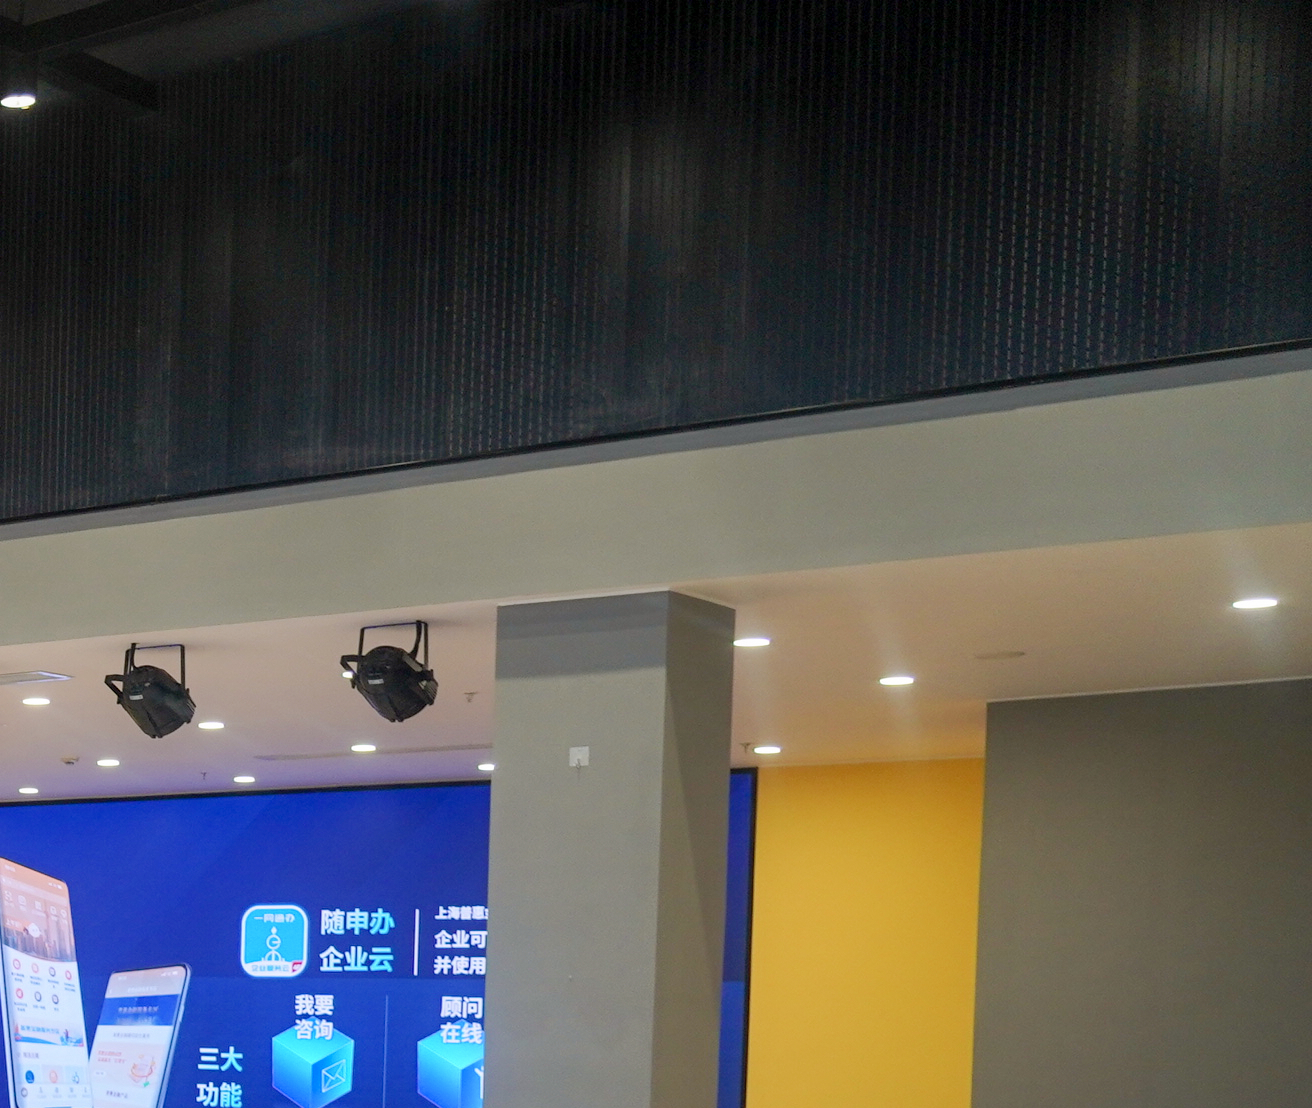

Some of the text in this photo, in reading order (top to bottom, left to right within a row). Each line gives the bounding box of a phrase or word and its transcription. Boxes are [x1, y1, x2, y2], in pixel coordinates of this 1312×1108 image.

[320, 908, 395, 936] 随申办
[434, 930, 488, 949] 企业可
[319, 945, 394, 973] 企业云
[433, 955, 486, 975] 并使用
[294, 994, 334, 1016] 我要
[440, 996, 483, 1019] 顾问
[294, 1019, 334, 1041] 咨询
[440, 1022, 484, 1044] 在线
[197, 1046, 243, 1072] 三大
[196, 1082, 242, 1108] 功能
